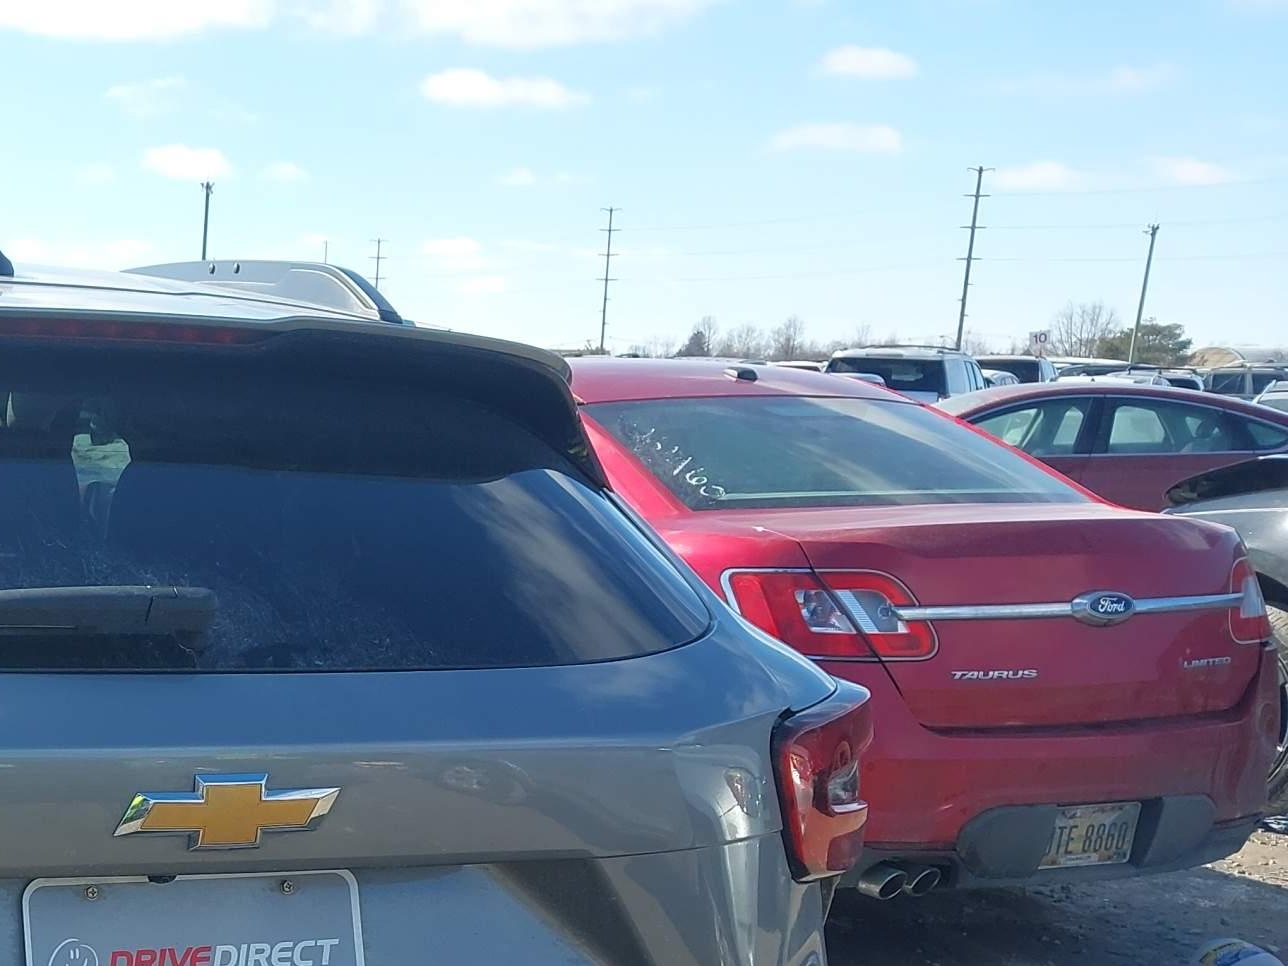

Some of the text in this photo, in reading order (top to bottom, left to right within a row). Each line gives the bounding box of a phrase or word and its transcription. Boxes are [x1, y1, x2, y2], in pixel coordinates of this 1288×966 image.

[1032, 332, 1048, 345] 10
[1098, 596, 1125, 613] Ford
[1183, 655, 1232, 669] LIMITED
[951, 668, 1039, 681] TAURUS
[1081, 821, 1129, 853] 8860
